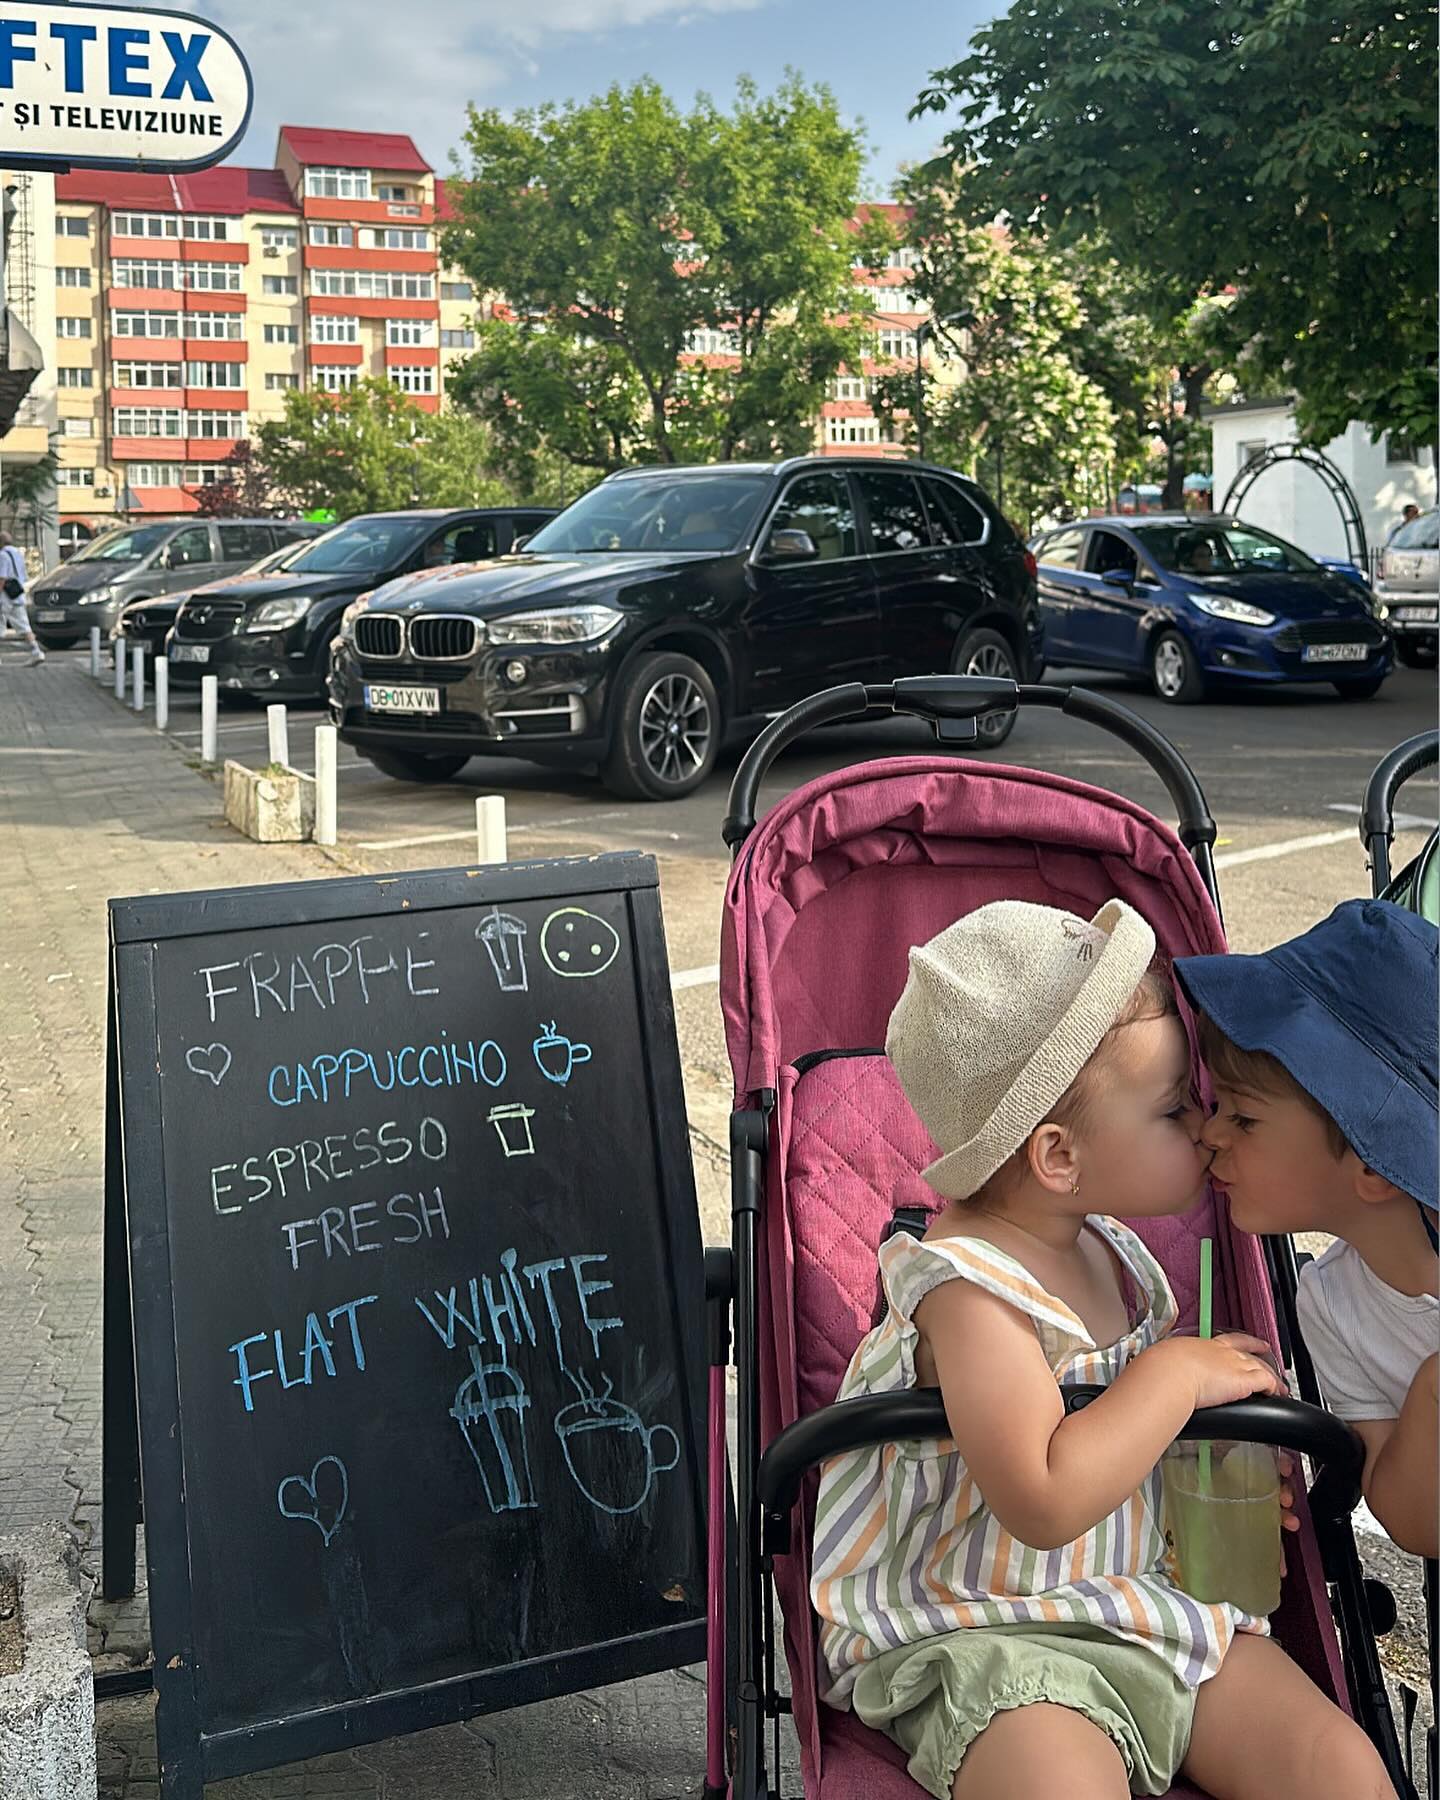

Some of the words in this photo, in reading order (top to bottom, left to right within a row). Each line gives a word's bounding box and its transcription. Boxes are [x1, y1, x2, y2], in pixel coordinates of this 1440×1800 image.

[0, 19, 214, 103] FTEX
[50, 105, 223, 136] TELEVIZIUNE
[210, 1116, 448, 1215] ESPRESSO
[281, 1186, 451, 1271] FRESH
[228, 1295, 379, 1412] FLAT
